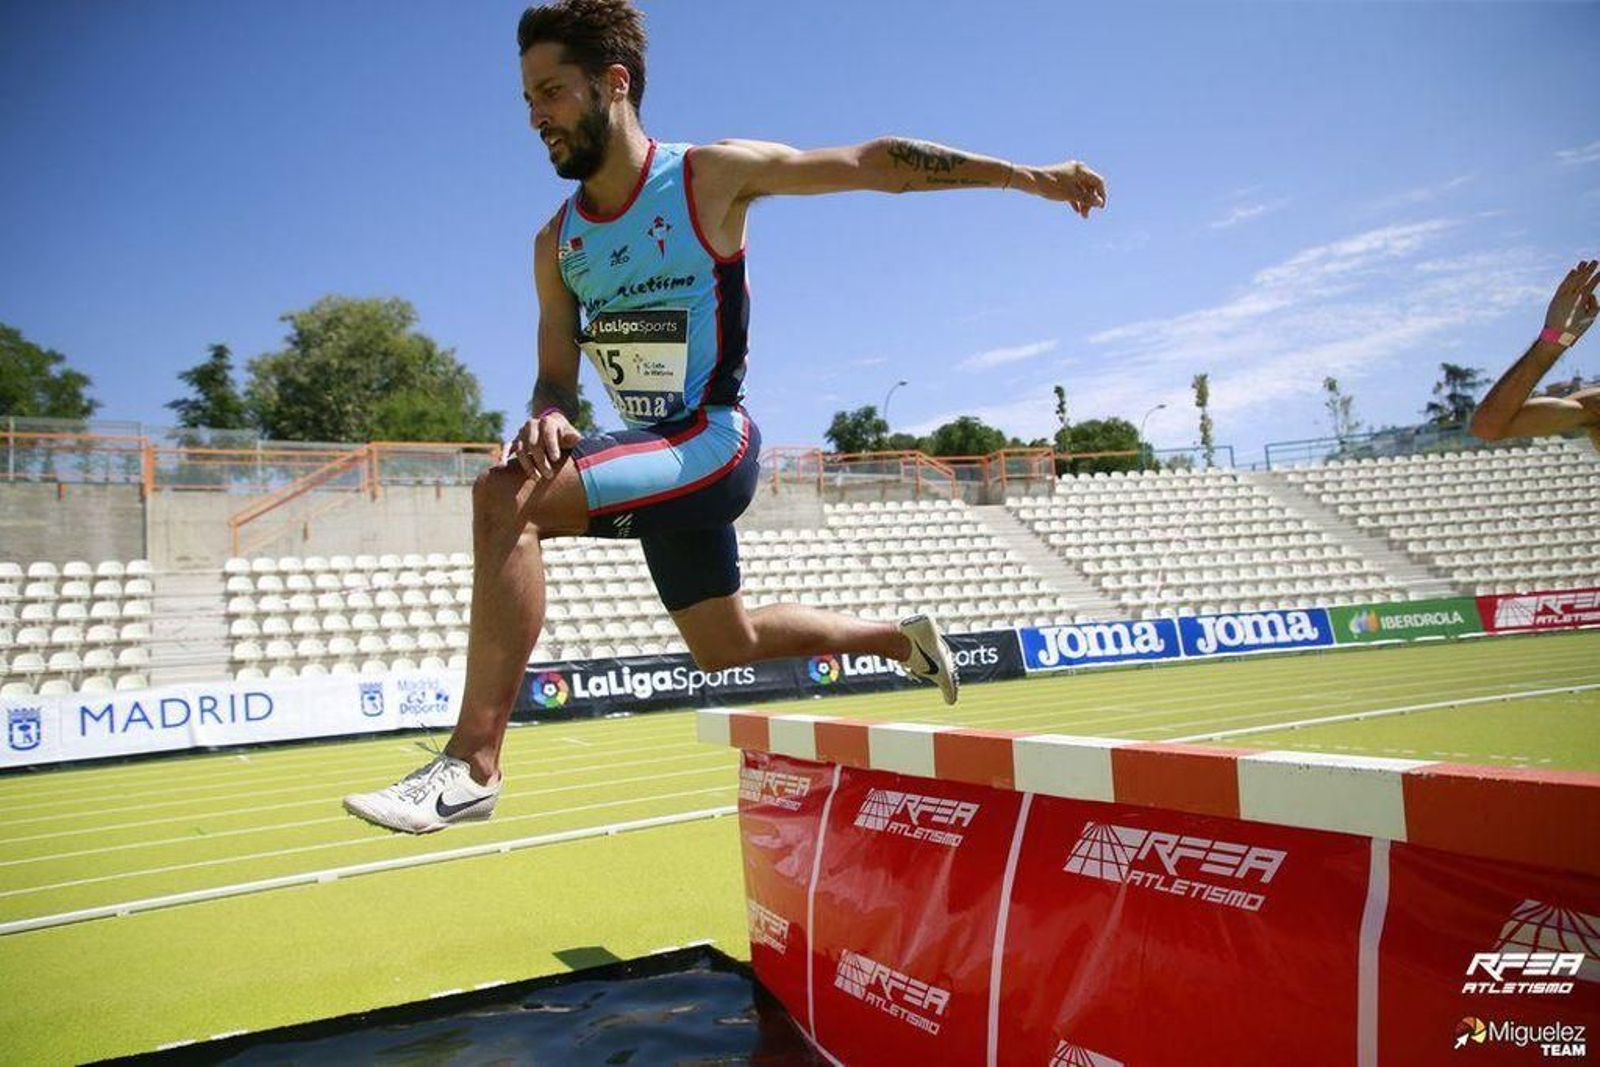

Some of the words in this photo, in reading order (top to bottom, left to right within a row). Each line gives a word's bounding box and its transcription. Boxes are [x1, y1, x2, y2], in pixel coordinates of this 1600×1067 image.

[599, 319, 677, 335] LaLigaSports
[1380, 611, 1464, 630] IBERDROLA
[572, 666, 755, 699] LaLigaSports
[80, 692, 273, 736] MADRID
[896, 794, 980, 828] RFEA
[887, 823, 963, 848] ATLETISMO
[1138, 830, 1288, 884] RFEA
[1126, 869, 1266, 911] ATLETISMO
[870, 961, 950, 1016] RFEA
[864, 994, 940, 1036] ATLETISMO
